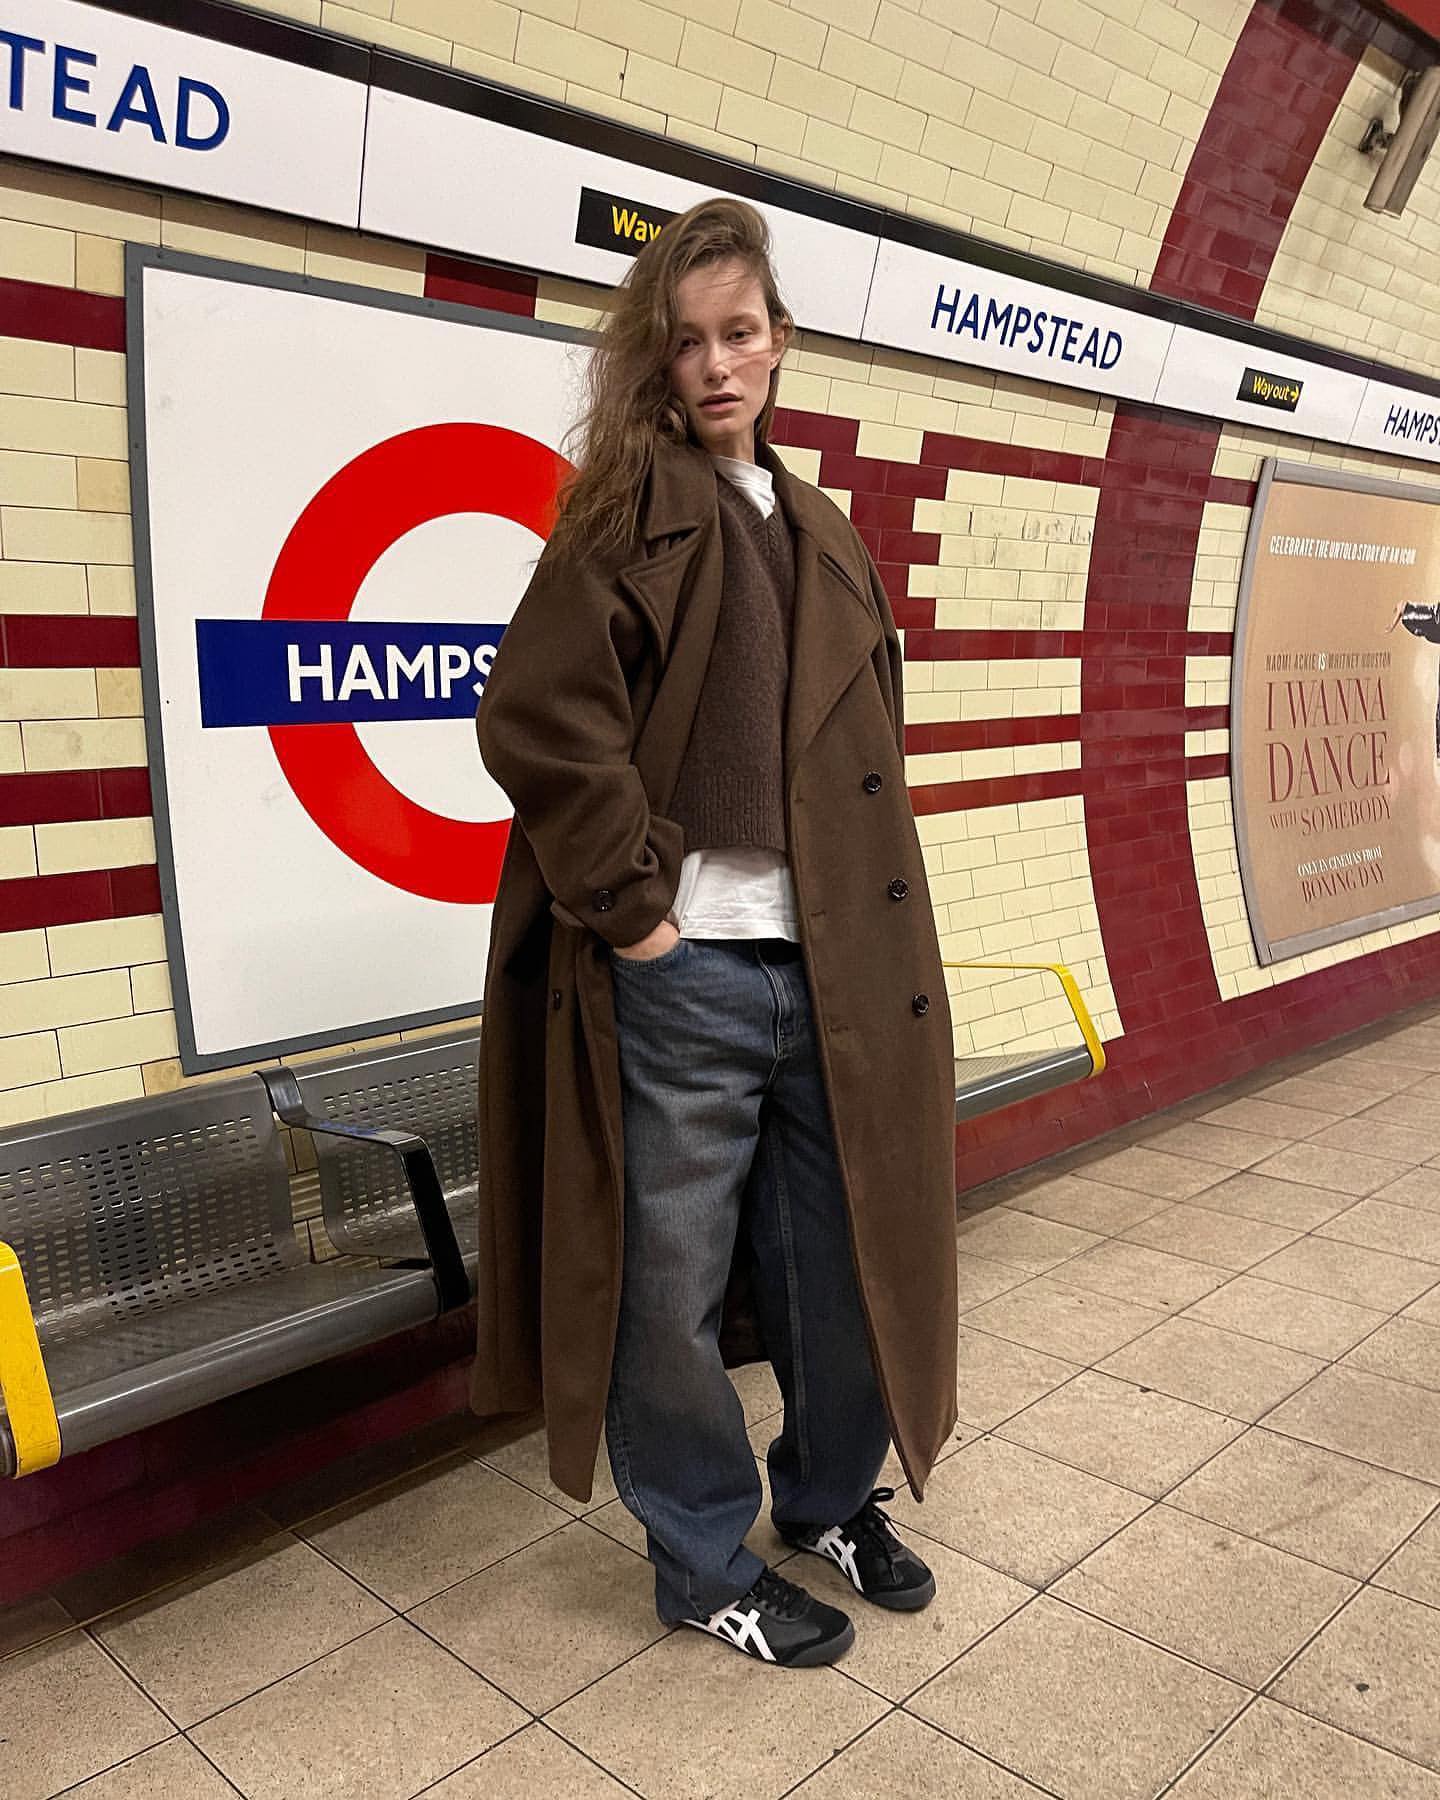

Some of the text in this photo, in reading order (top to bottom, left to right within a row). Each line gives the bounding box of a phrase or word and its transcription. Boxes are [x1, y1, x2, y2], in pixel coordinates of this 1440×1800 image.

[0, 30, 230, 151] TEAD
[930, 284, 1122, 370] HAMPSTEAD
[1253, 375, 1290, 401] Way out
[1270, 535, 1417, 565] CELEBRATE THE UNTOLD STORY OF AN ICON
[287, 643, 498, 702] HAMPS
[1265, 650, 1392, 672] NAOMI ACKIE IS WHITNEY HOUSTON
[1266, 677, 1388, 731] I WANNA
[1265, 731, 1390, 803] DANCE
[1269, 795, 1391, 836] WITH SOMEBODY
[1297, 845, 1384, 876] ONLY IN CINEMAS FROM
[1302, 862, 1384, 904] BOXING DAY
